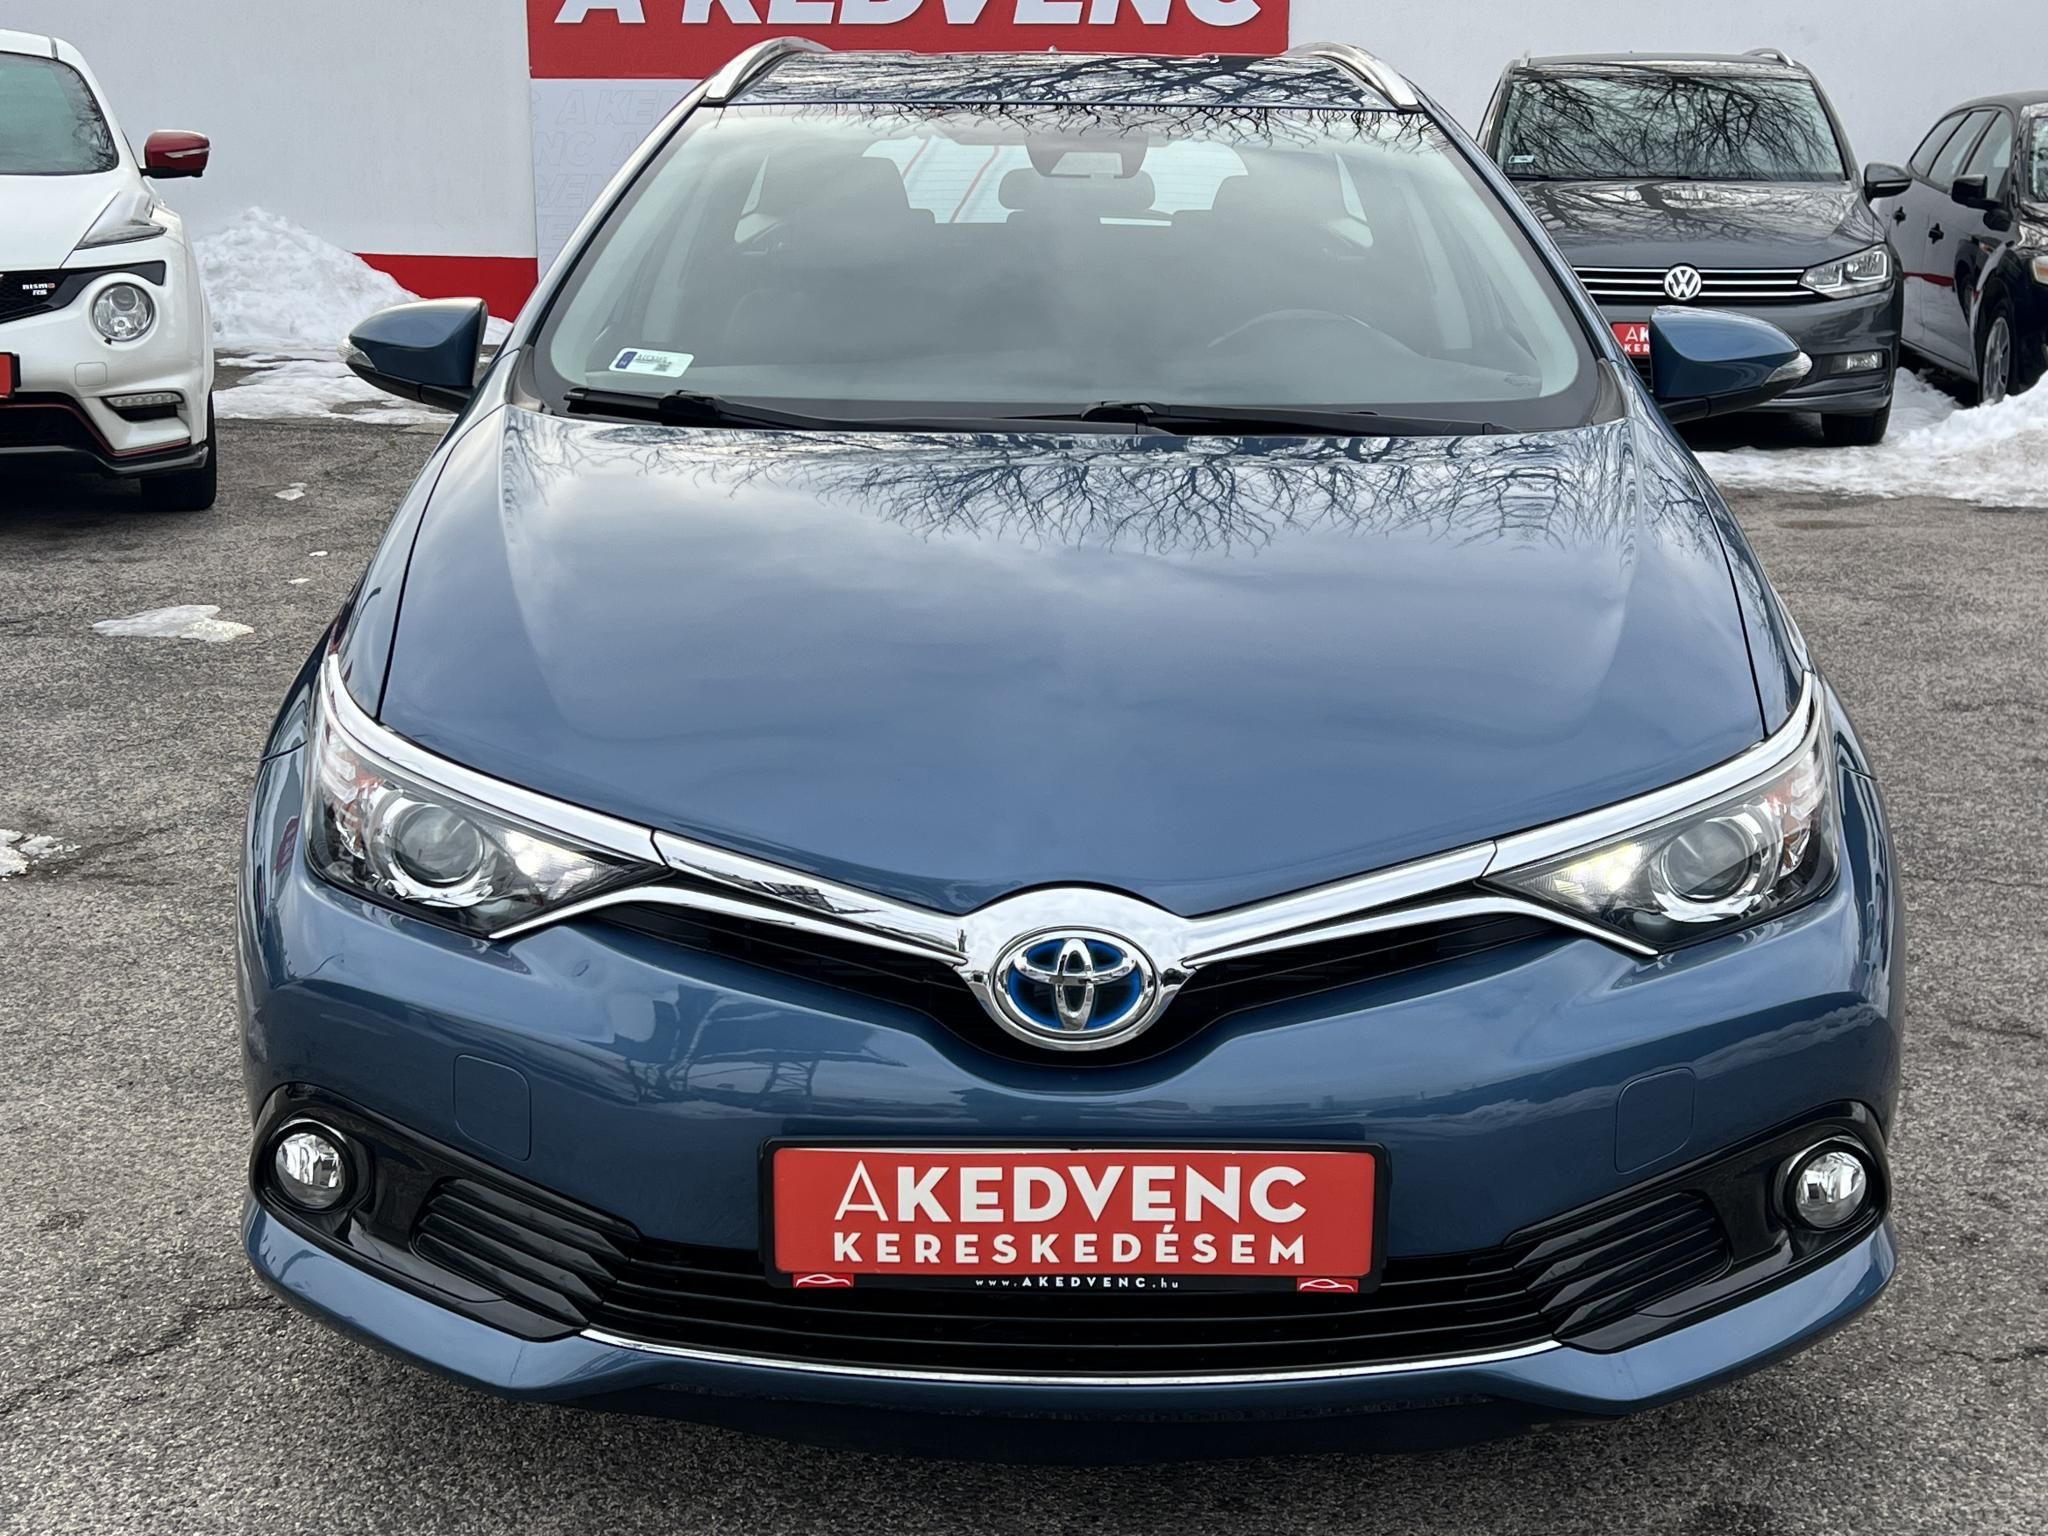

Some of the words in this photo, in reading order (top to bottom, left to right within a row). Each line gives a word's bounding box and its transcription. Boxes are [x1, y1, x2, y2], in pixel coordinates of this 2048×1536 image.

[834, 1159, 1307, 1224] AKEDVENC
[833, 1224, 1304, 1265] KERESKEDÉSEM
[975, 1276, 1179, 1289] www.AKEDVENC.hu
